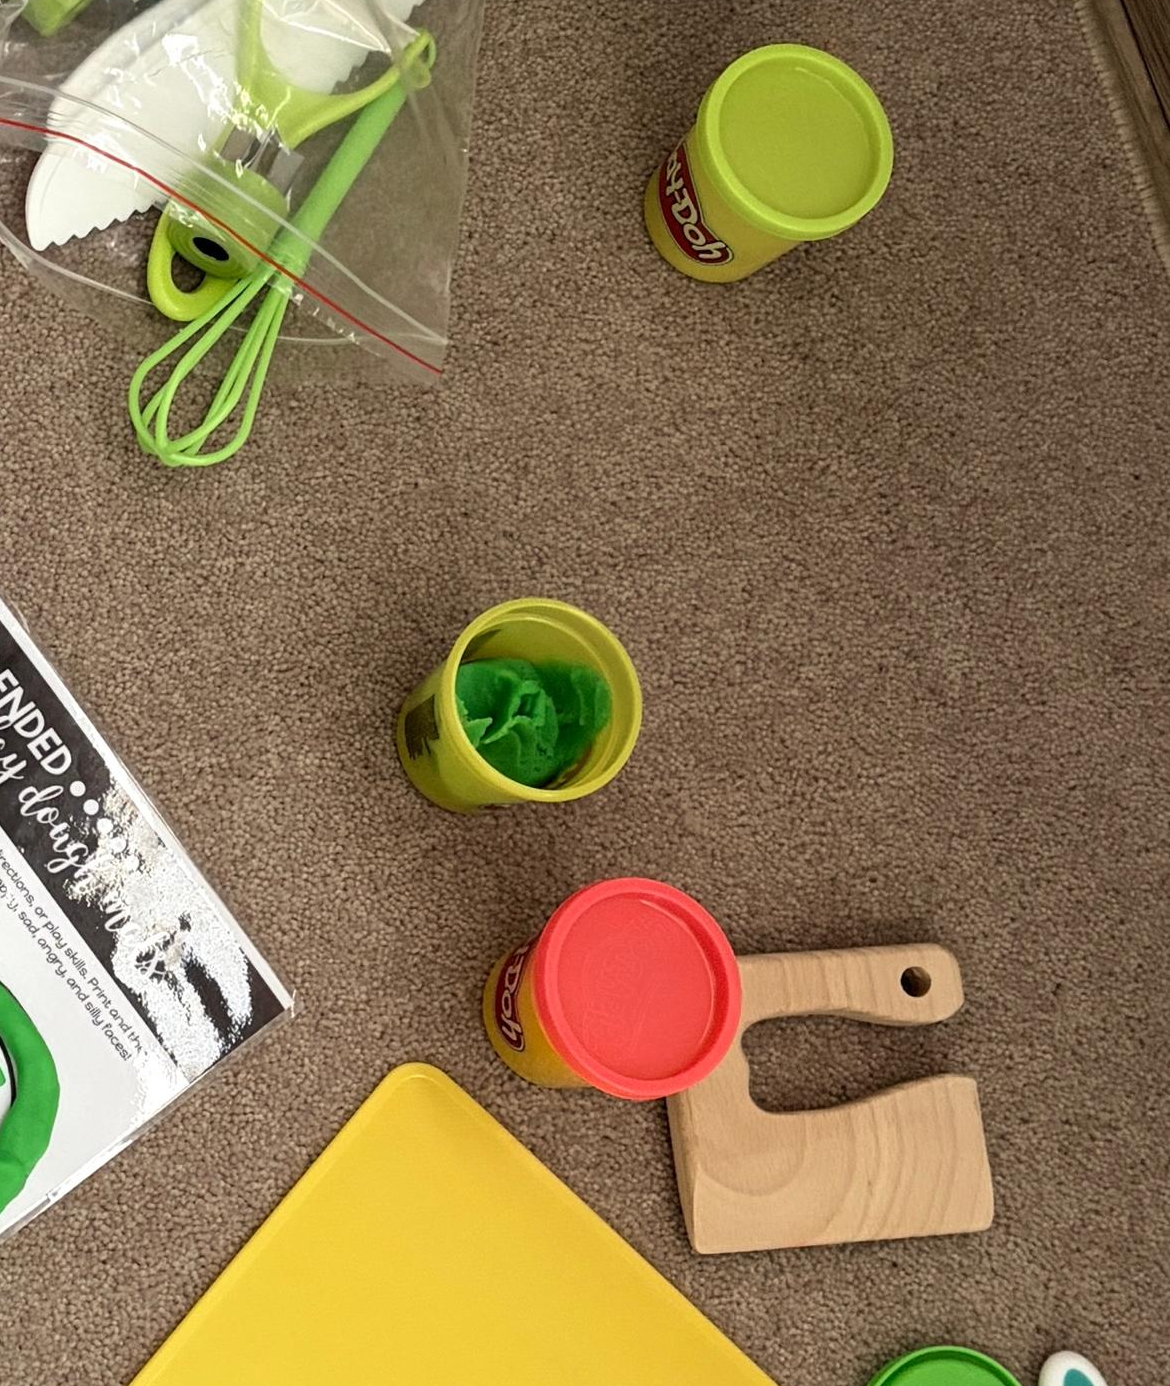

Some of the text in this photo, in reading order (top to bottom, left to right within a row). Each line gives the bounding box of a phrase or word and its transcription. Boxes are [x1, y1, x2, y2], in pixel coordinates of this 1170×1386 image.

[18, 911, 40, 939] sad,
[37, 938, 67, 978] angry,
[66, 978, 90, 1002] and
[84, 1001, 104, 1027] silly
[101, 1022, 132, 1061] faces!
[34, 906, 48, 919] or
[42, 921, 68, 950] play
[64, 947, 88, 980] skills.
[87, 977, 112, 1009] Print
[109, 1008, 132, 1033] and
[127, 1031, 148, 1056] th
